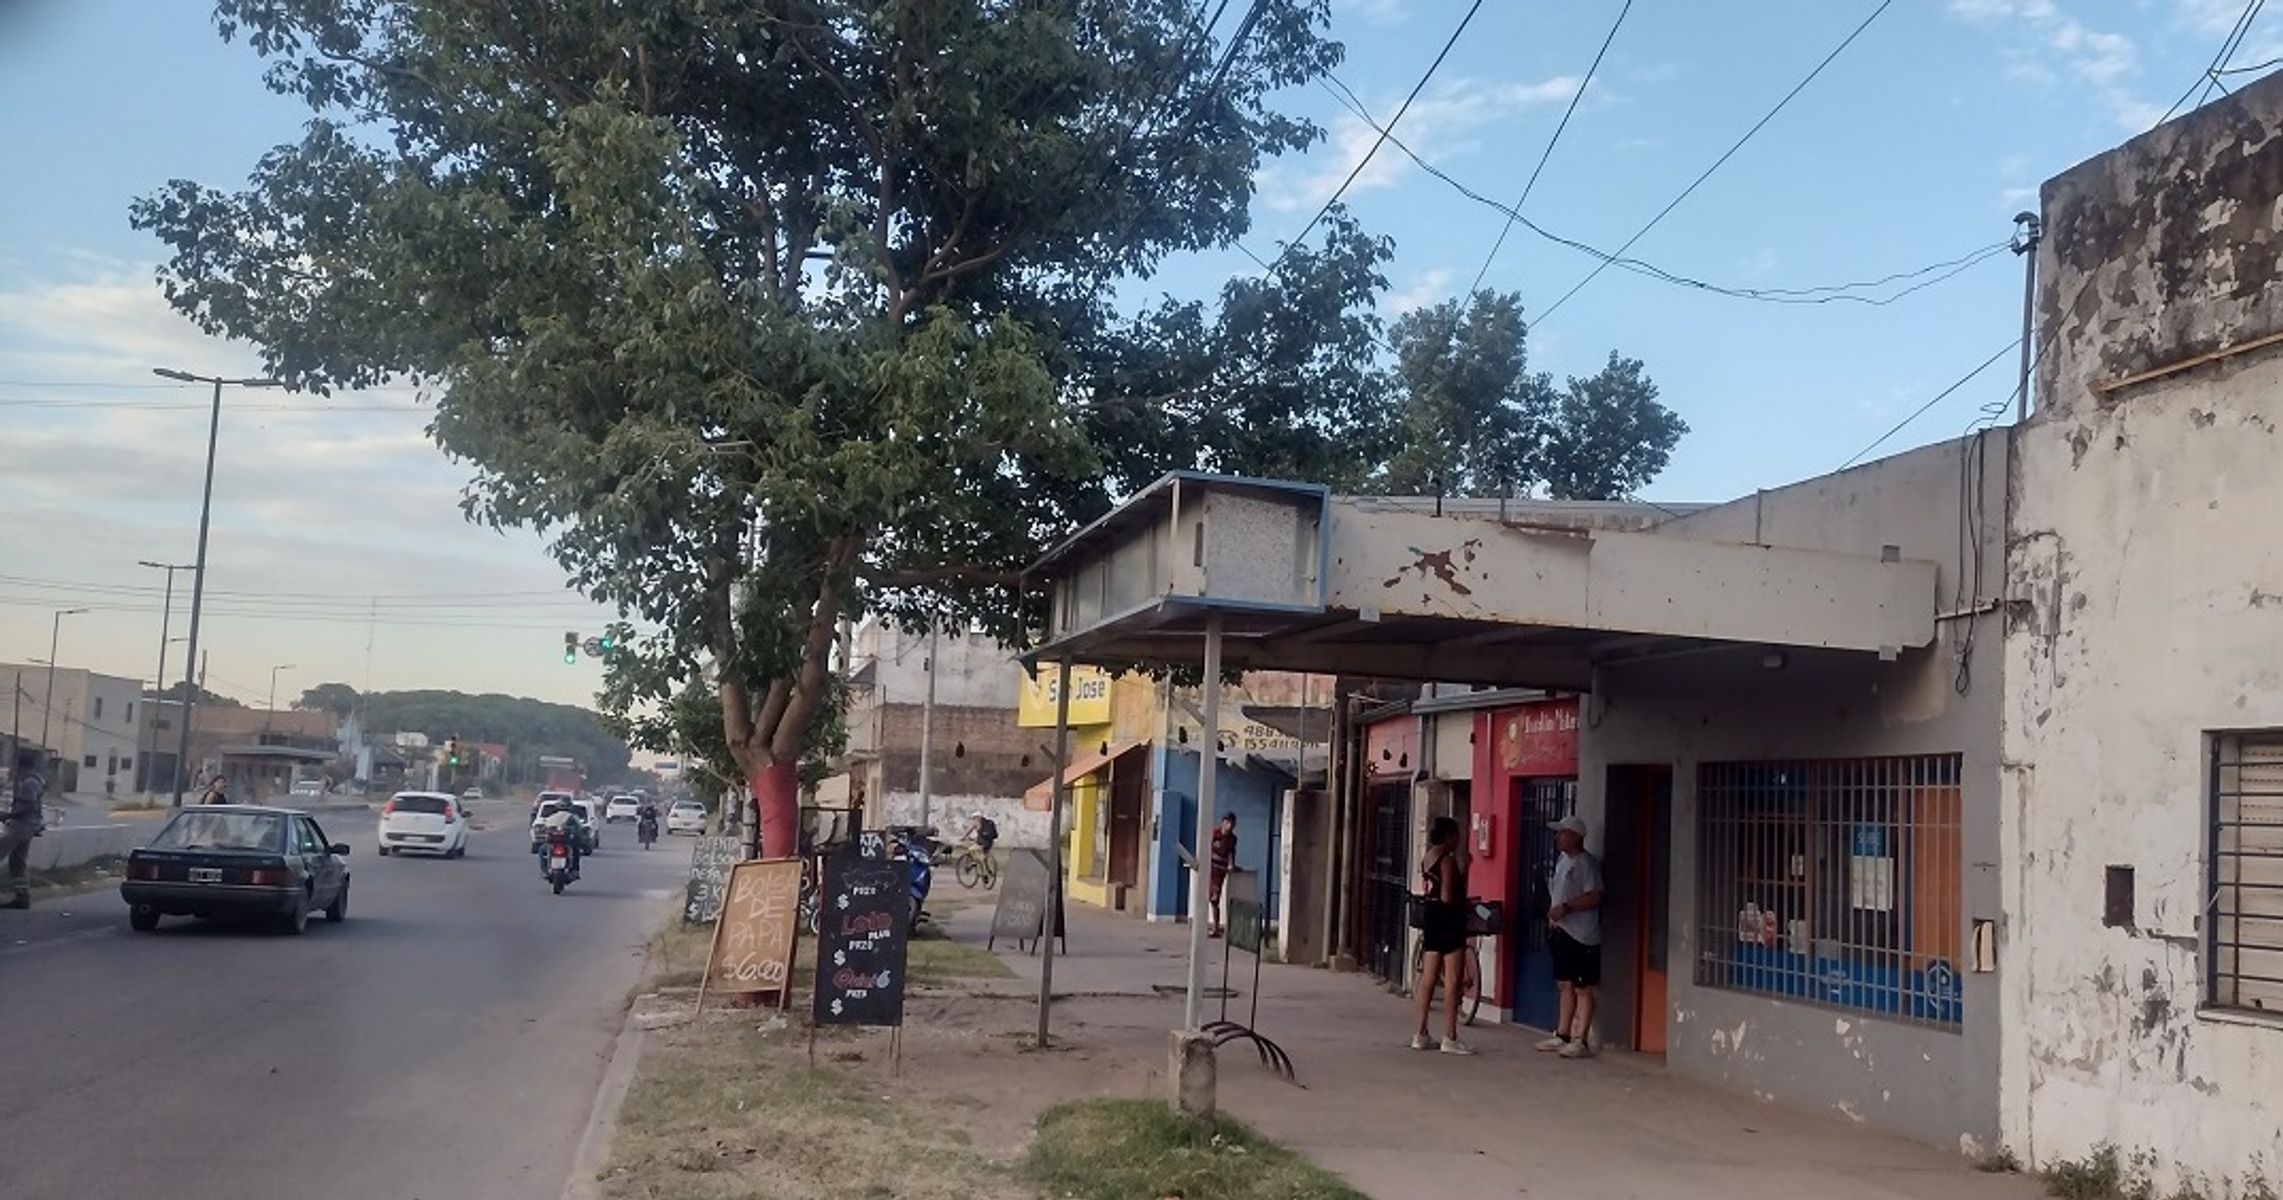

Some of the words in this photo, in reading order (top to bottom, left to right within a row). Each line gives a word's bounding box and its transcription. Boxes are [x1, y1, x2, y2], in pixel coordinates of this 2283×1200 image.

[749, 895, 787, 918] DE
[837, 893, 850, 910] $
[841, 910, 894, 935] Loto
[727, 919, 783, 950] PAPA
[833, 949, 846, 967] $
[830, 998, 843, 1016] $
